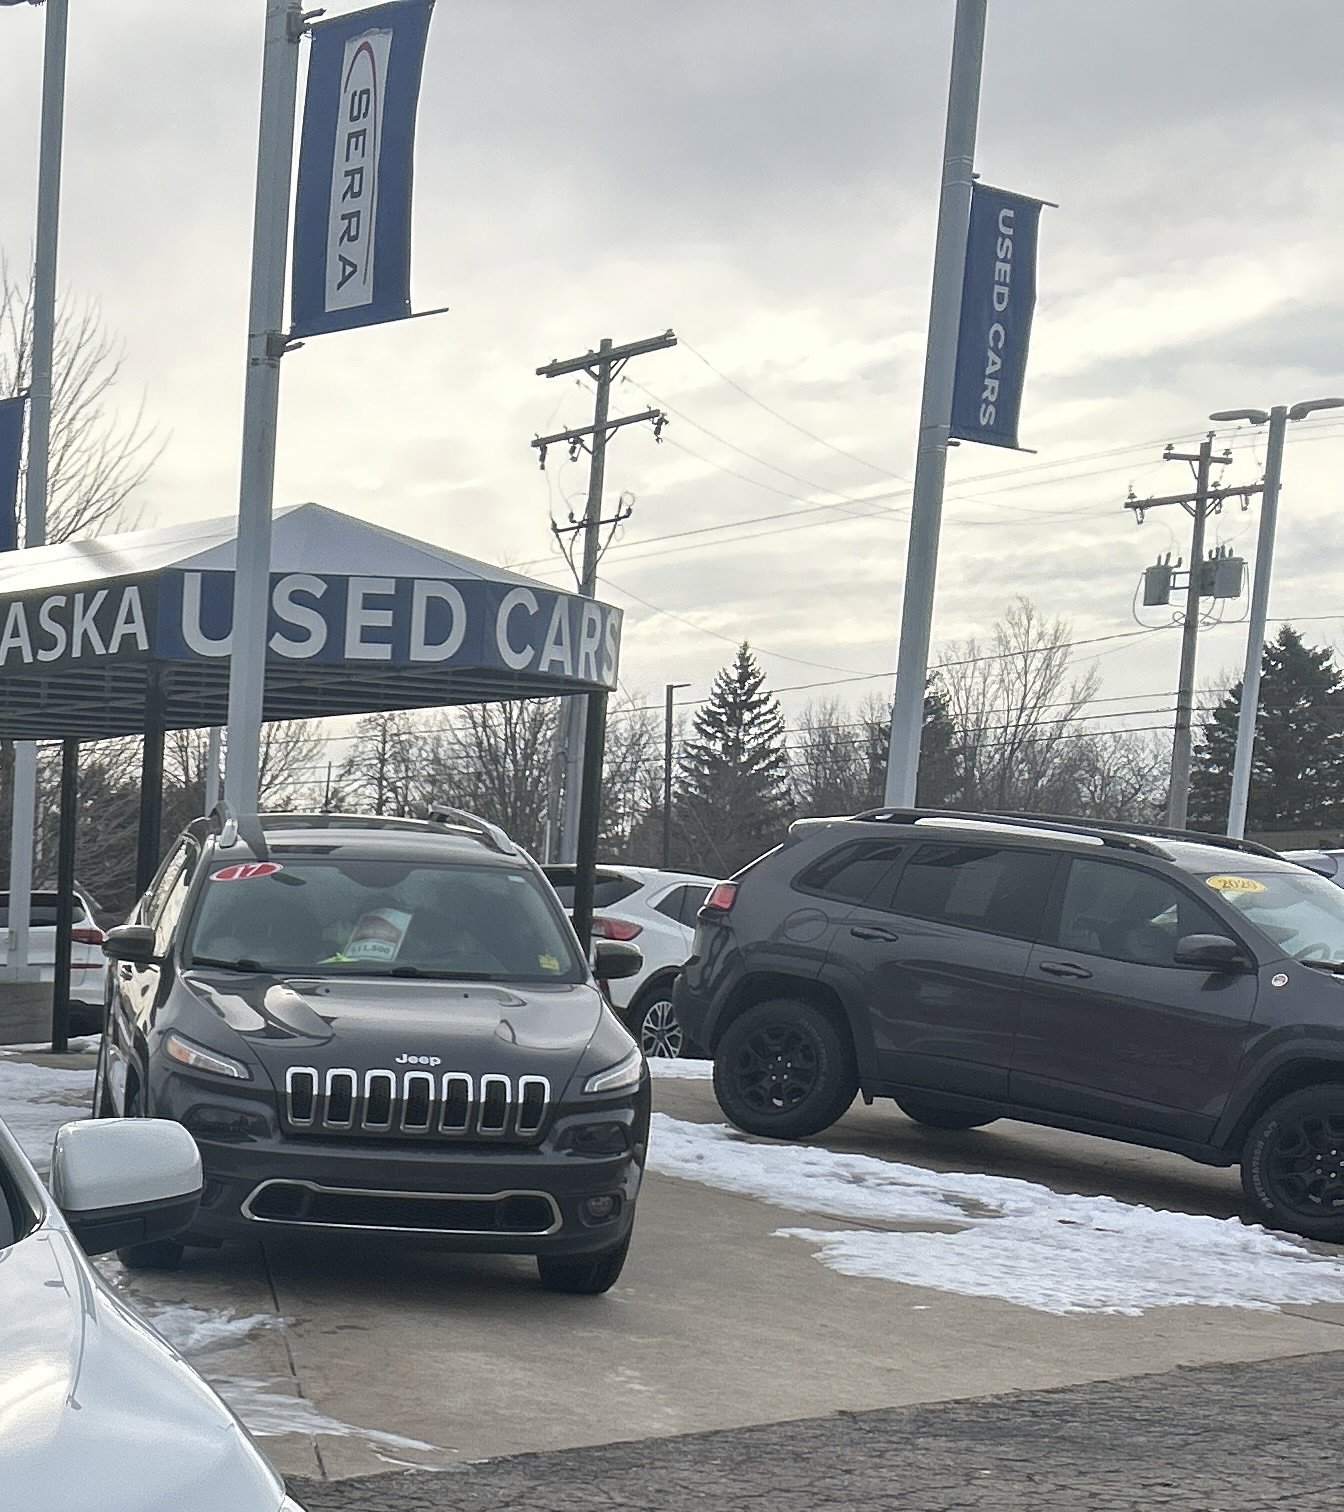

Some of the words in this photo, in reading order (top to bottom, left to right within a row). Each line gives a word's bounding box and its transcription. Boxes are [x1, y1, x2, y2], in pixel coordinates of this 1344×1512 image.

[336, 88, 371, 292] SERRA
[992, 207, 1015, 312] USED
[979, 322, 1006, 427] CARS
[181, 571, 467, 662] USED
[496, 586, 622, 683] CARS
[232, 863, 264, 879] 17
[395, 1053, 441, 1066] Jeep
